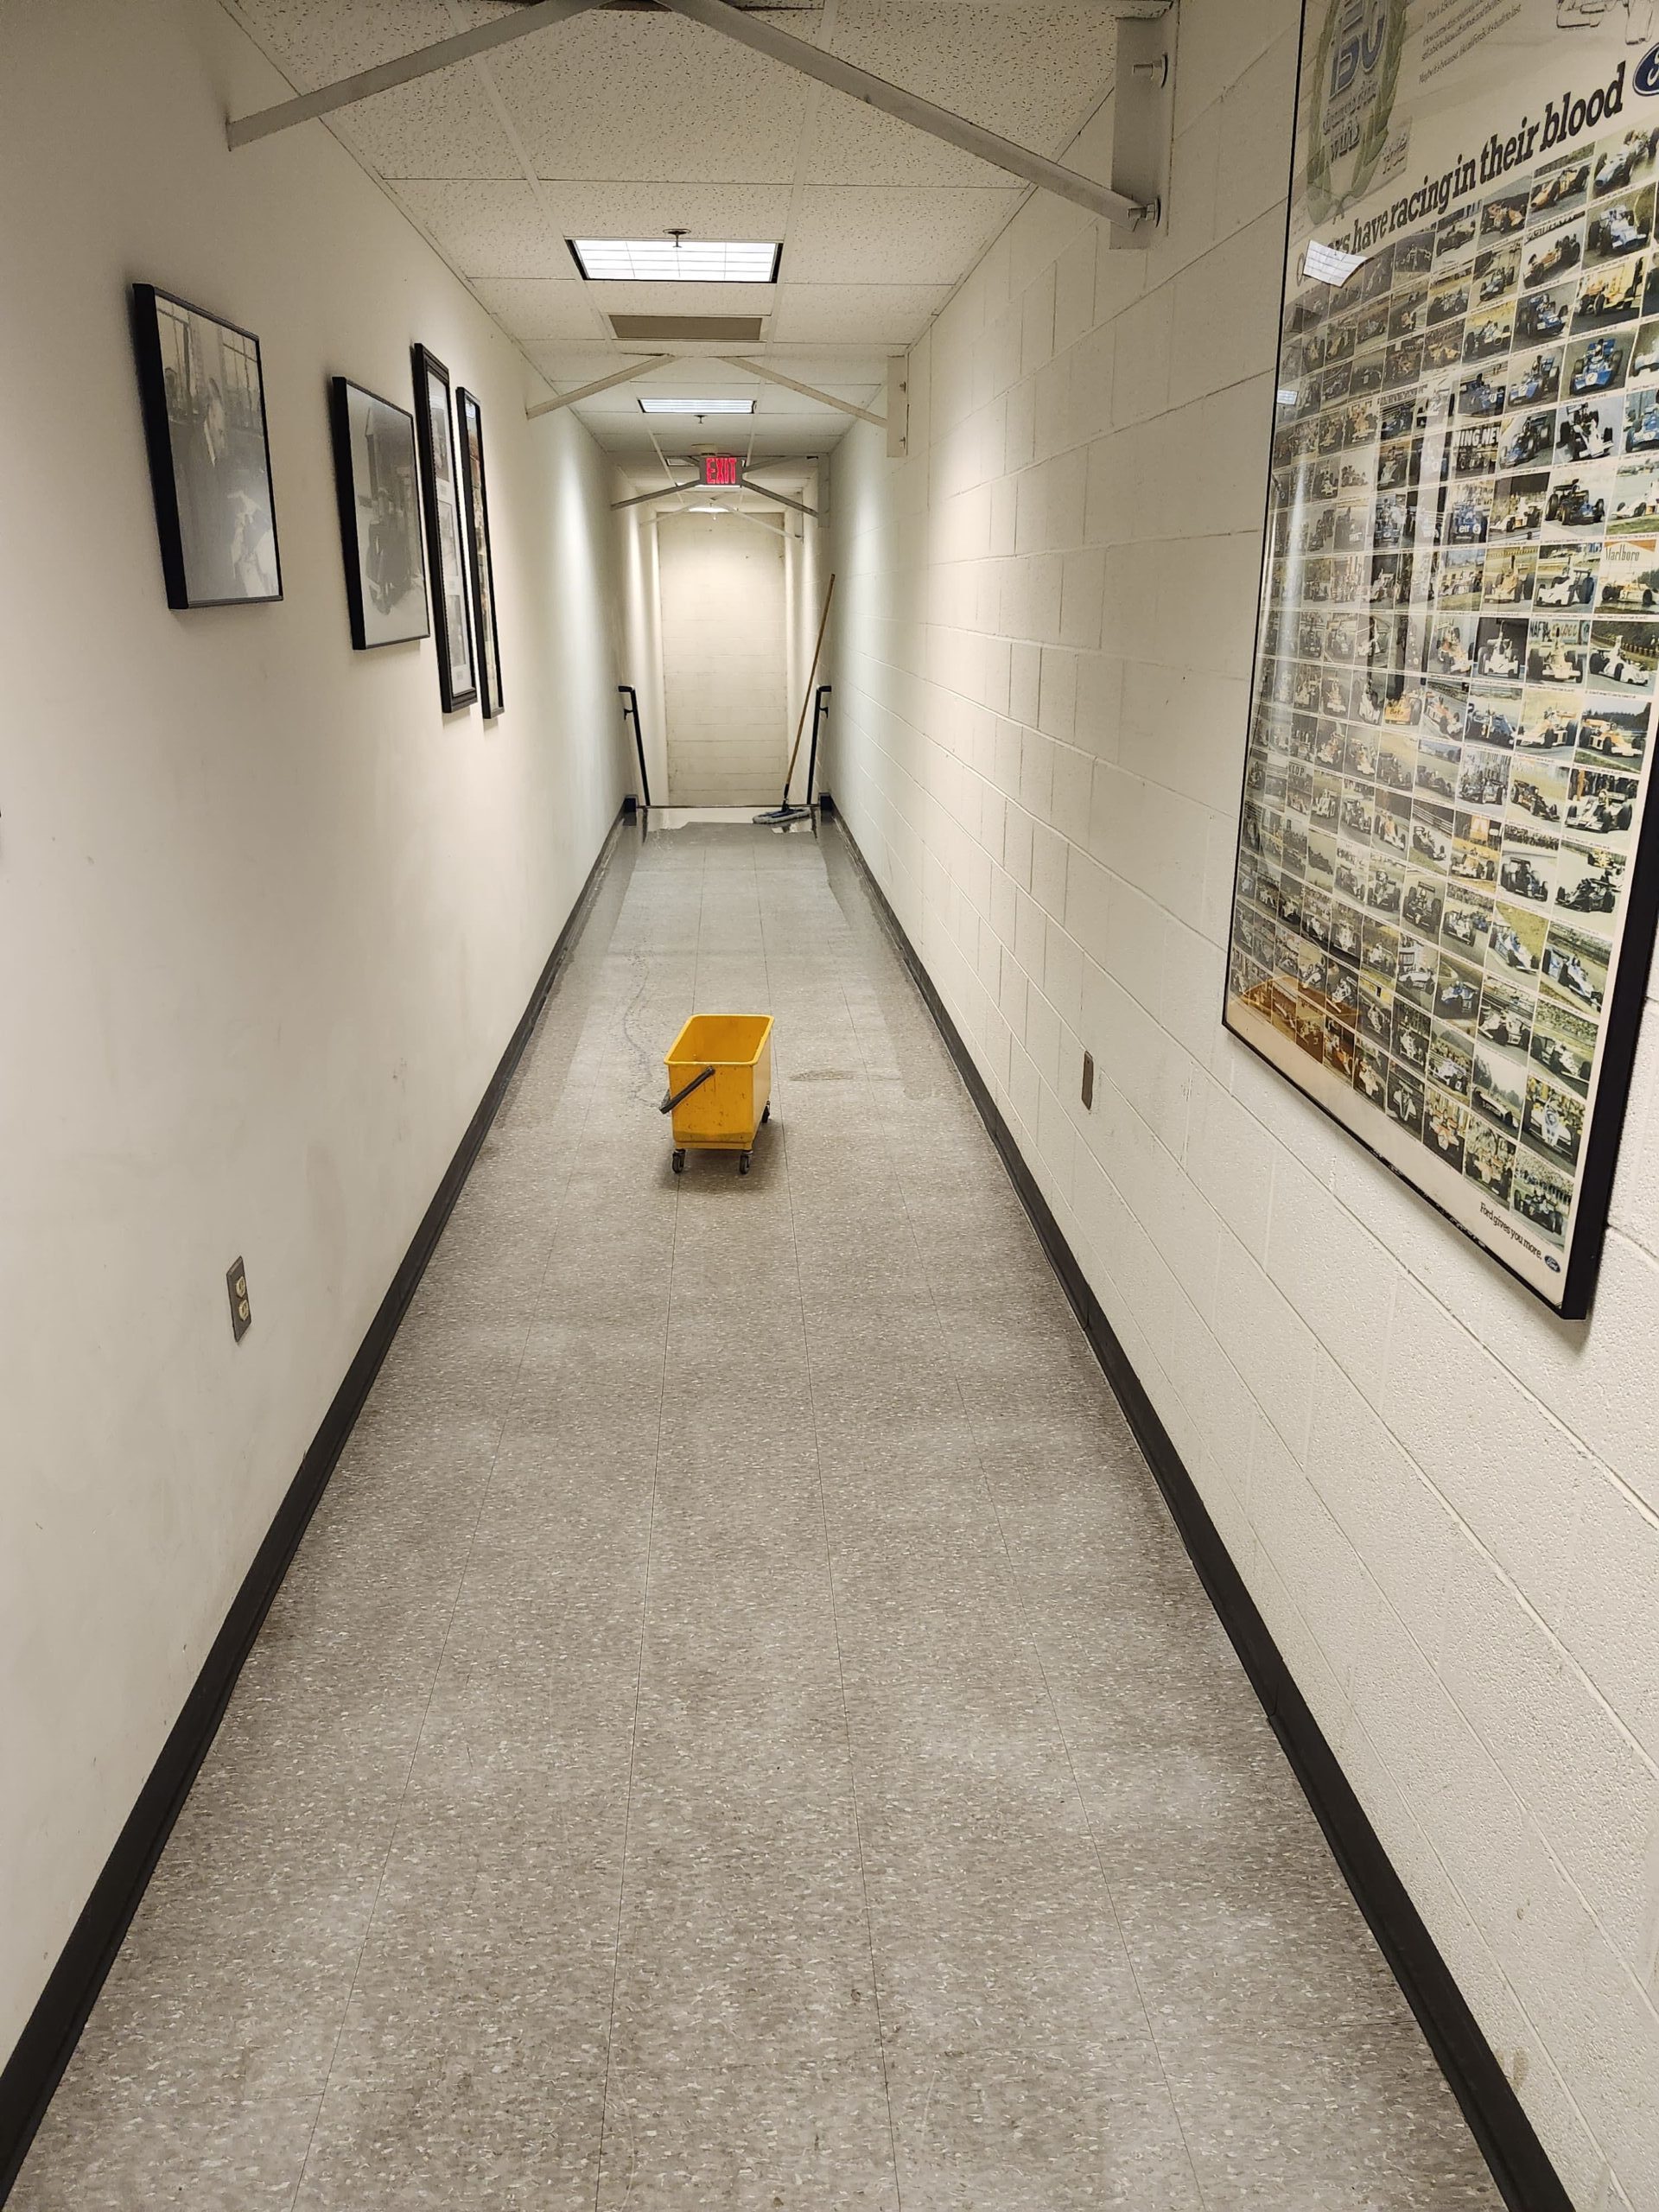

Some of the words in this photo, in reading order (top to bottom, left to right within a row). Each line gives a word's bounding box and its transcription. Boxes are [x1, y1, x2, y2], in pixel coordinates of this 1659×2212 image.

[1351, 210, 1388, 255] have
[1389, 171, 1452, 232] racing
[1452, 154, 1476, 199] in
[1478, 116, 1540, 184] their
[1539, 60, 1626, 152] blood
[706, 457, 737, 484] EXIT
[1479, 1201, 1494, 1220] Ford
[1493, 1215, 1510, 1234] gives
[1510, 1229, 1523, 1245] you
[1522, 1237, 1542, 1261] more.
